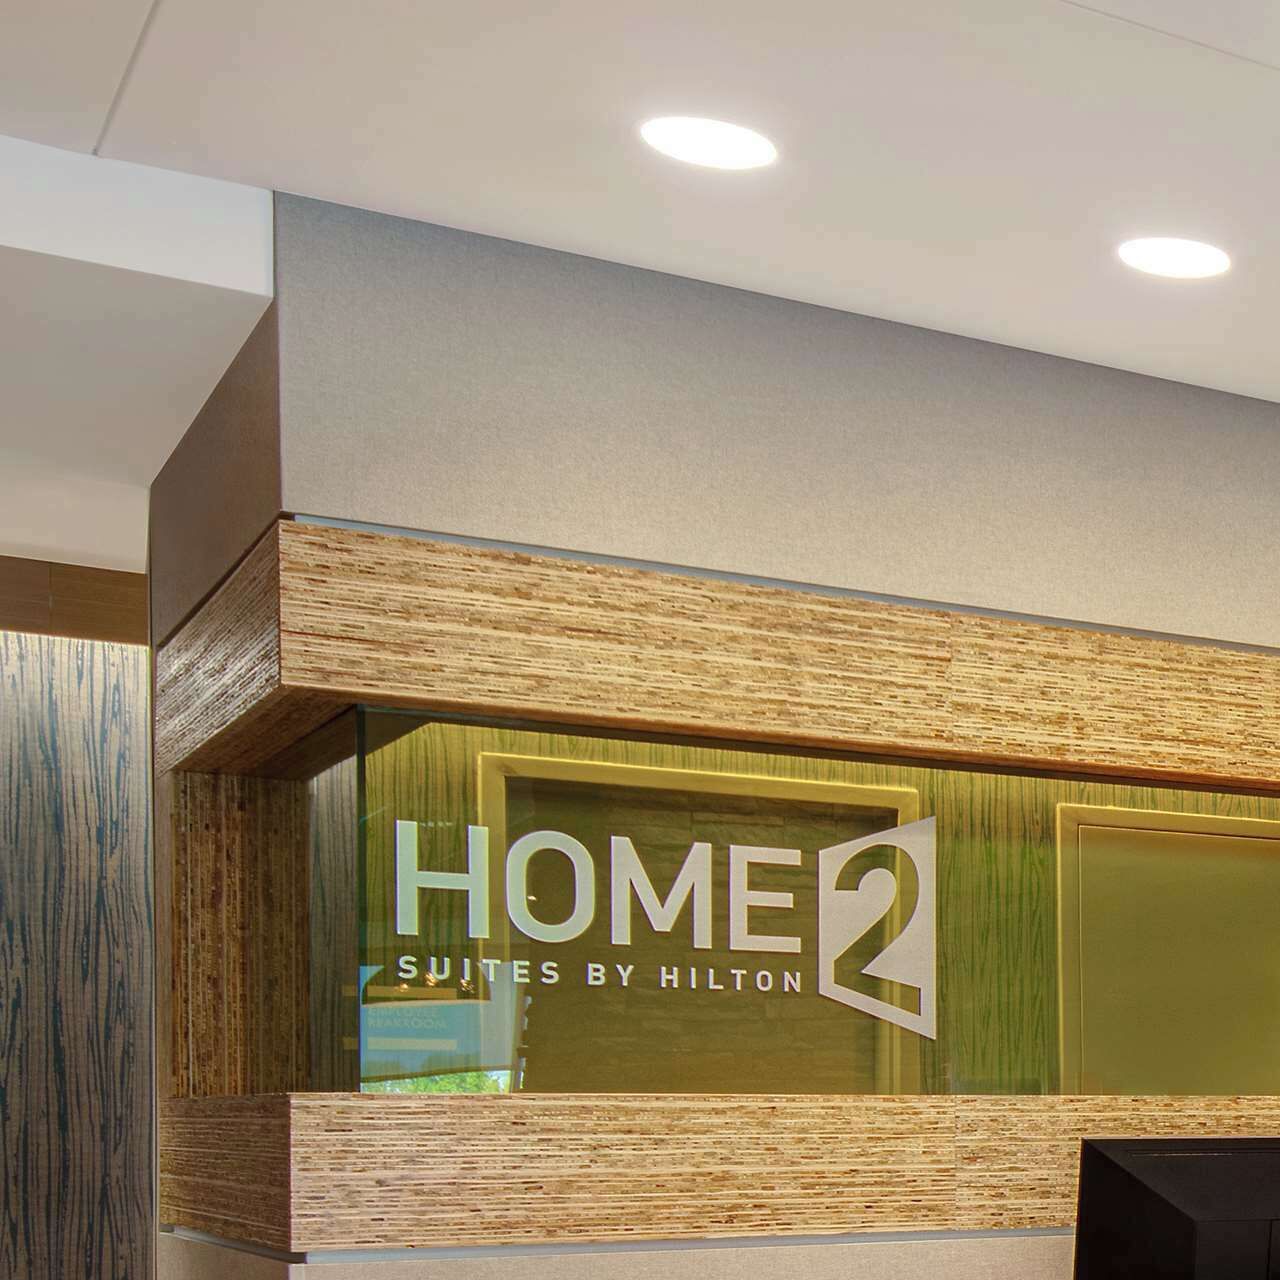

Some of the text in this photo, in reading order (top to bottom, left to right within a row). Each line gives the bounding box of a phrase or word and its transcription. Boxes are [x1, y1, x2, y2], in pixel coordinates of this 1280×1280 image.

[396, 819, 801, 953] HOME
[398, 955, 801, 993] SUITES BY HILTON
